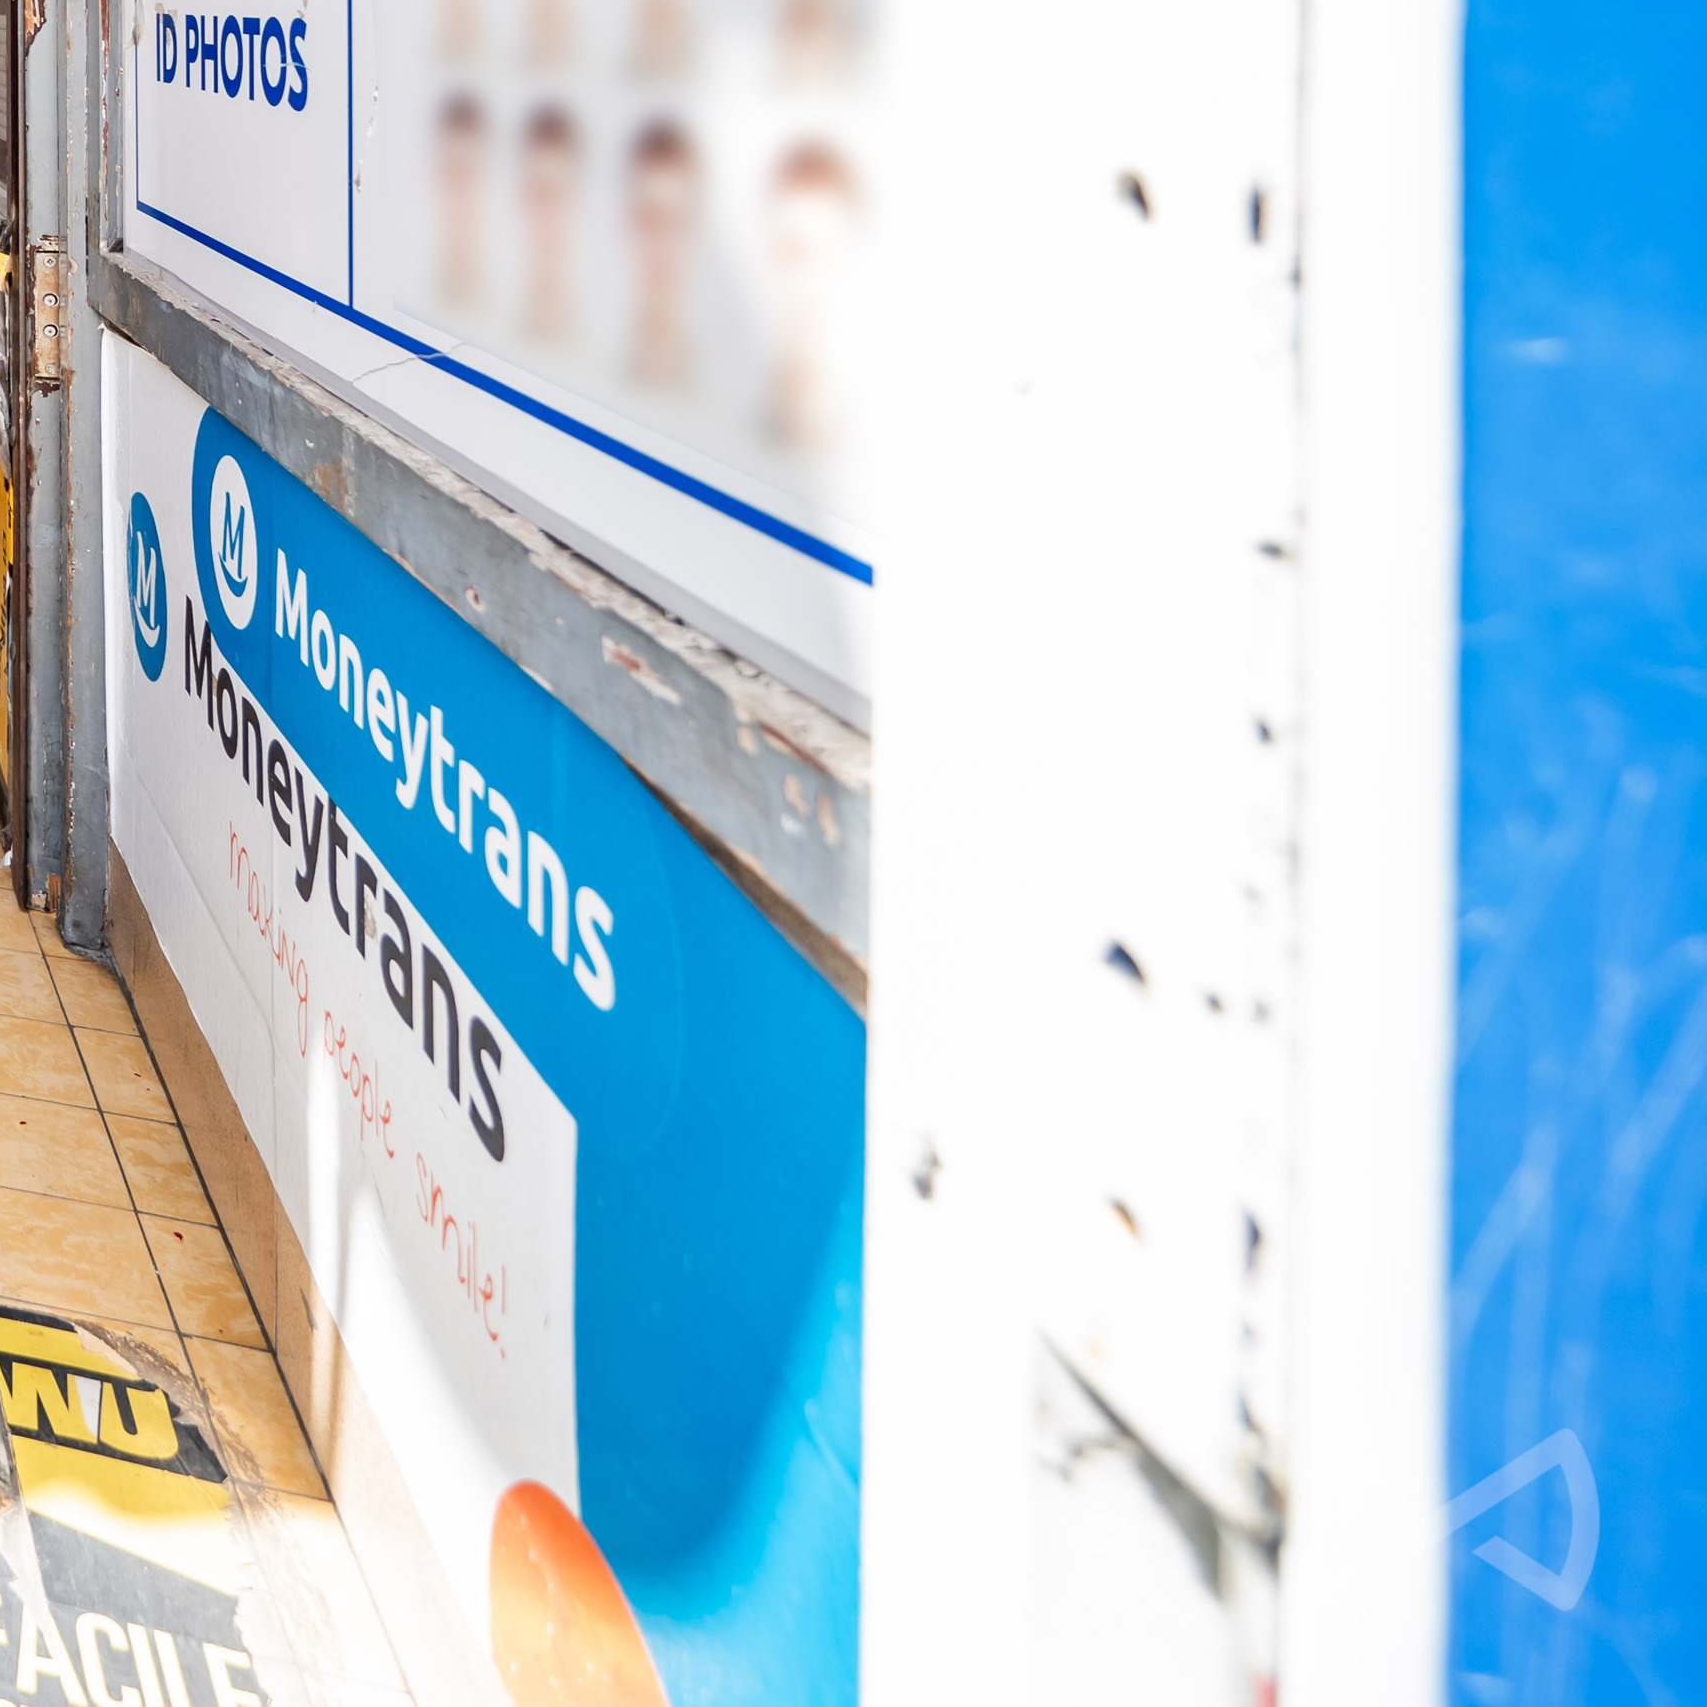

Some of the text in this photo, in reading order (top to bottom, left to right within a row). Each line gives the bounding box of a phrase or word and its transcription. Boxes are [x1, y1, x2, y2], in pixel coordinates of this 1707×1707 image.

[156, 13, 309, 112] ID PHOTOS
[185, 594, 507, 1164] Moneytrans
[274, 547, 616, 1014] Moneytrans
[229, 821, 508, 1361] making people smile!
